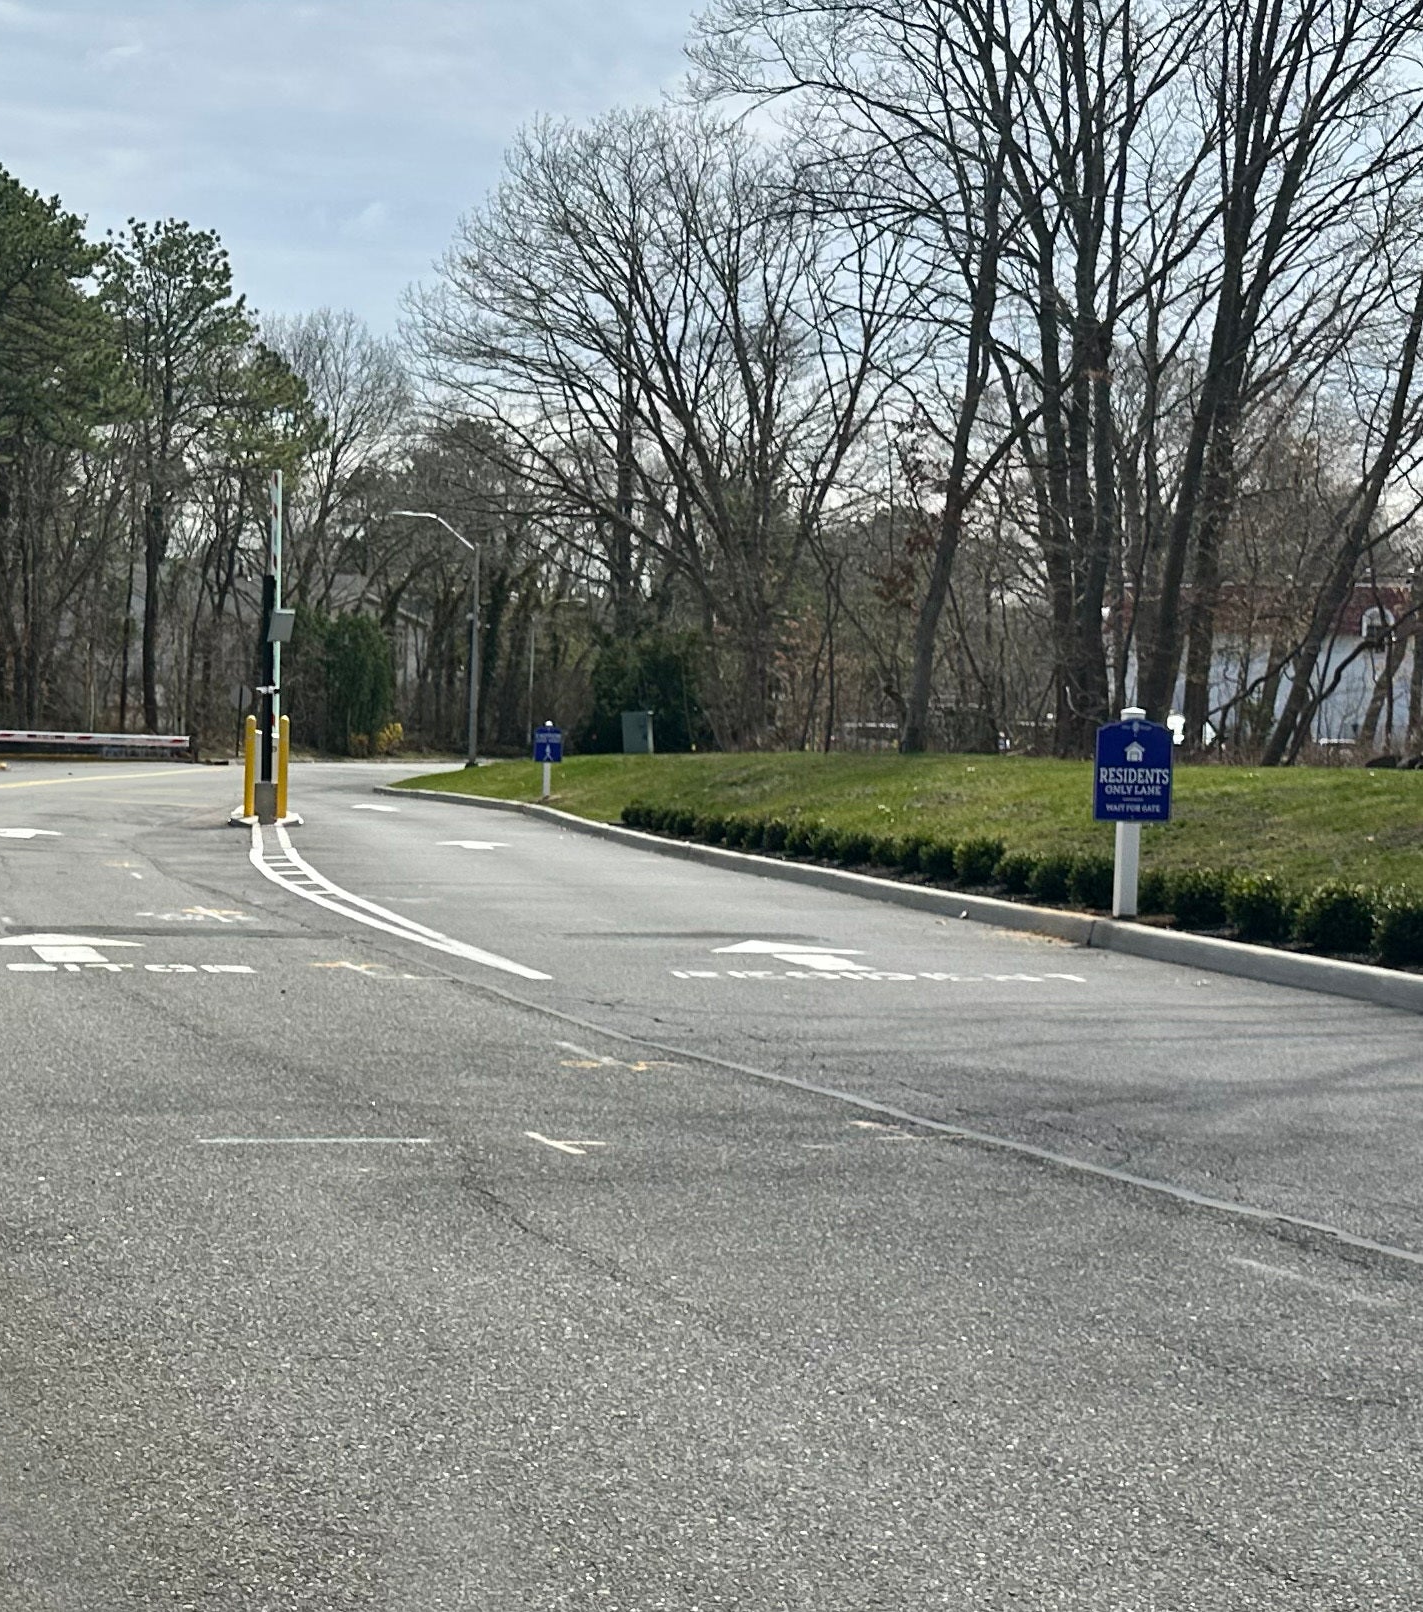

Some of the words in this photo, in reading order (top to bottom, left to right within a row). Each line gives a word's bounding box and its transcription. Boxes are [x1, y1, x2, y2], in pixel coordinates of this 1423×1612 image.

[1099, 767, 1169, 785] RESIDENTS
[1104, 785, 1133, 795] ONLY
[1134, 786, 1161, 796] LANE
[1105, 803, 1126, 813] WAIT
[1141, 804, 1161, 814] GATE
